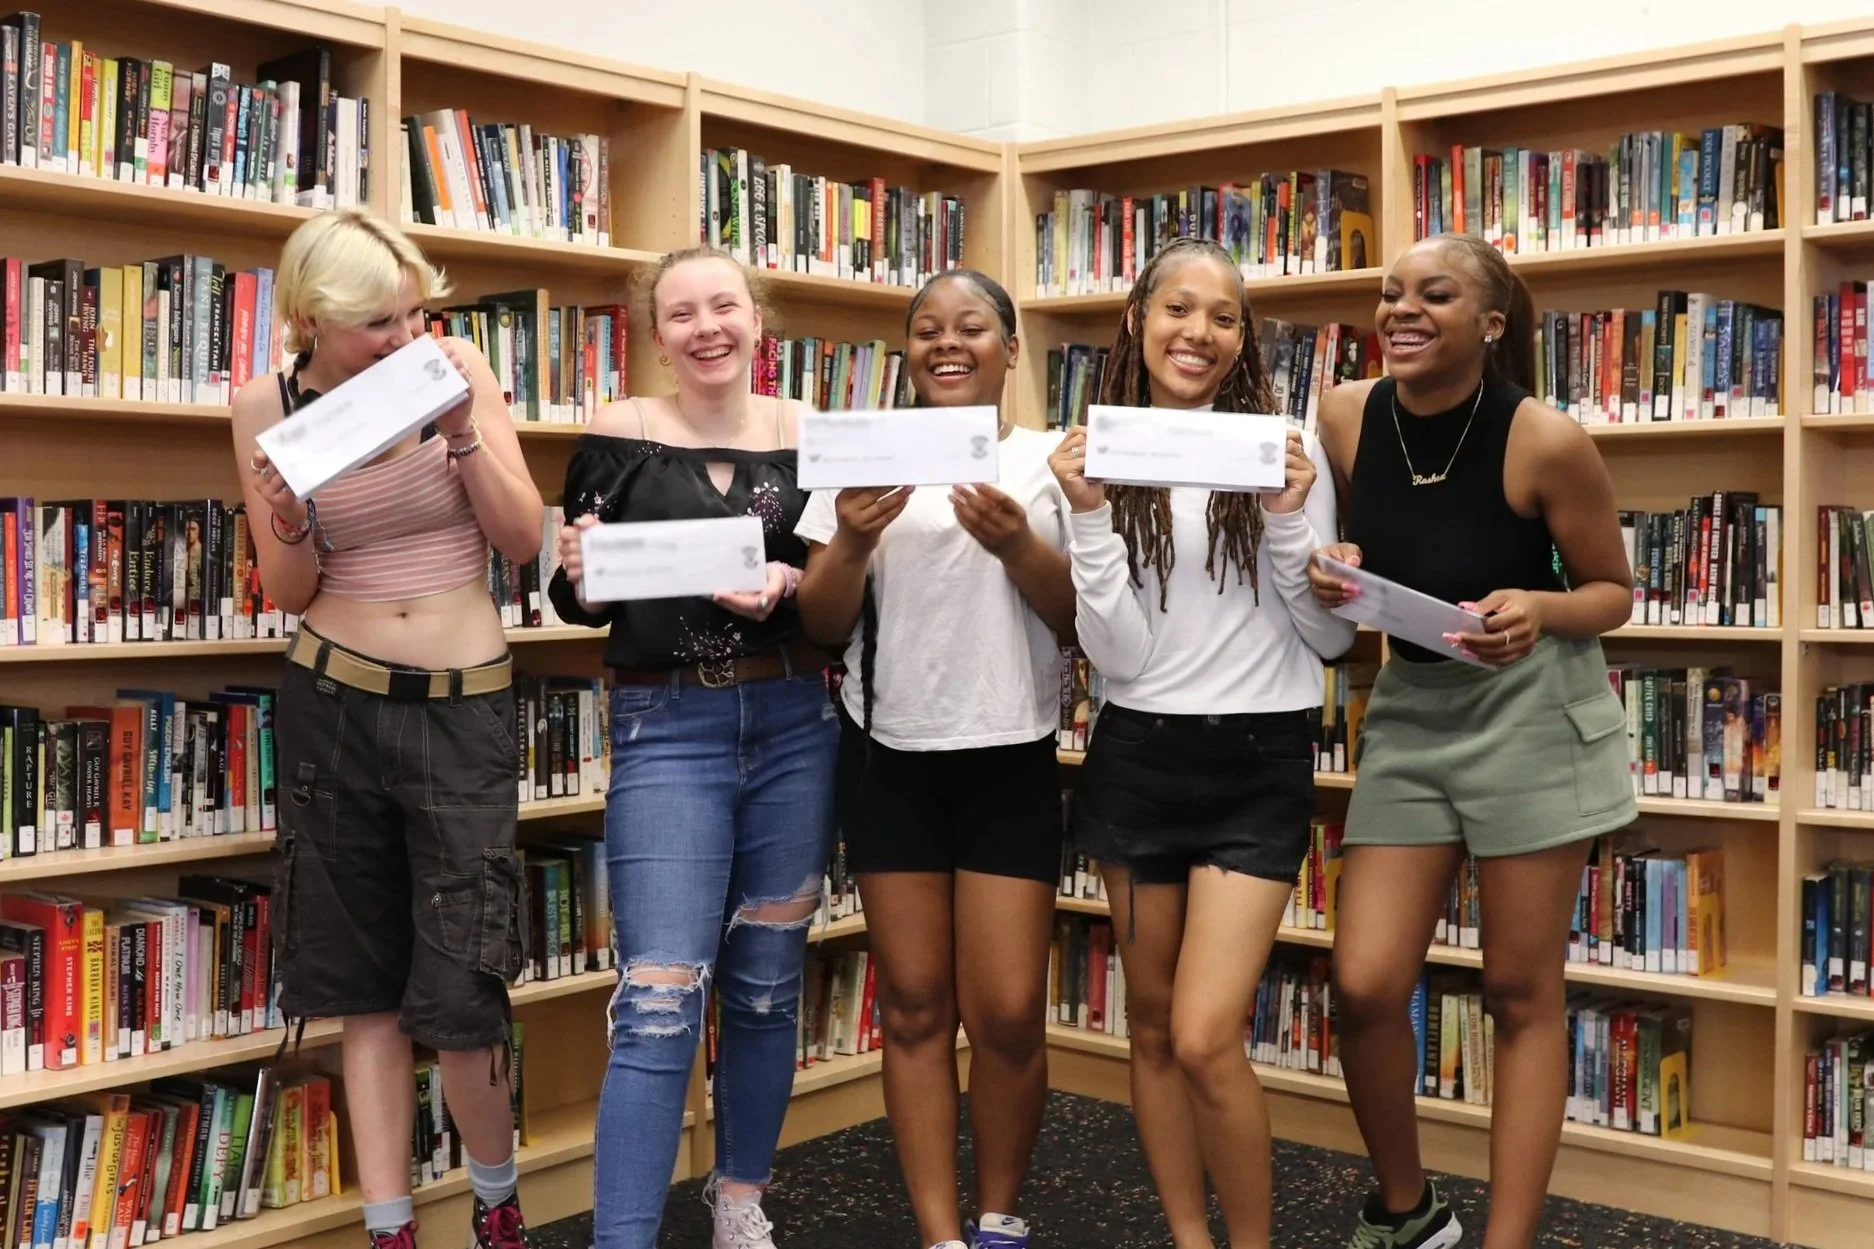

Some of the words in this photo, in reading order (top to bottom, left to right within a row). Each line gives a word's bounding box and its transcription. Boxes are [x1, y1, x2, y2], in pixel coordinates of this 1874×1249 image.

[153, 68, 163, 89] Girl
[160, 70, 170, 102] Funny
[7, 73, 17, 120] RAVEN'S
[6, 123, 16, 151] GATE
[149, 116, 161, 154] Hornby
[1703, 154, 1713, 191] PICOULT
[730, 179, 740, 204] SON
[753, 176, 766, 202] EGG
[754, 203, 765, 211] &
[173, 283, 182, 309] Kazuo
[201, 268, 210, 309] ITANI
[82, 303, 90, 333] IRVING
[171, 310, 181, 343] Ishiguro
[88, 339, 96, 354] THE
[768, 337, 777, 378] FACING
[87, 357, 95, 384] FOURT
[768, 380, 777, 396] TH
[1711, 517, 1721, 530] ARE
[1710, 531, 1721, 560] FOREVER
[95, 568, 107, 606] STOLE
[128, 551, 139, 591] Entice
[143, 551, 155, 592] Endure
[1709, 563, 1719, 585] KATHY
[1707, 586, 1717, 603] REIC
[123, 730, 133, 749] GUY
[25, 746, 33, 808] RAPTURE
[122, 752, 132, 788] GAVRIEL
[163, 747, 172, 784] ENGLISH
[122, 792, 132, 810] KAY
[237, 911, 245, 944] WALKING
[33, 935, 41, 977] STEPHEN
[121, 936, 131, 975] PLATINUM
[135, 928, 145, 966] DIAMOND
[65, 957, 73, 993] STEPHEN
[89, 957, 100, 993] BARBARA
[33, 981, 41, 1005] KING
[65, 996, 73, 1017] KING
[175, 1003, 184, 1022] One
[1426, 1006, 1440, 1067] HOMELAND
[199, 1104, 212, 1140] BATMAN
[213, 1132, 230, 1181] DEFY
[106, 1165, 117, 1195] GIRLS
[24, 1178, 38, 1215] FIFTEEN
[123, 1200, 134, 1225] WALL
